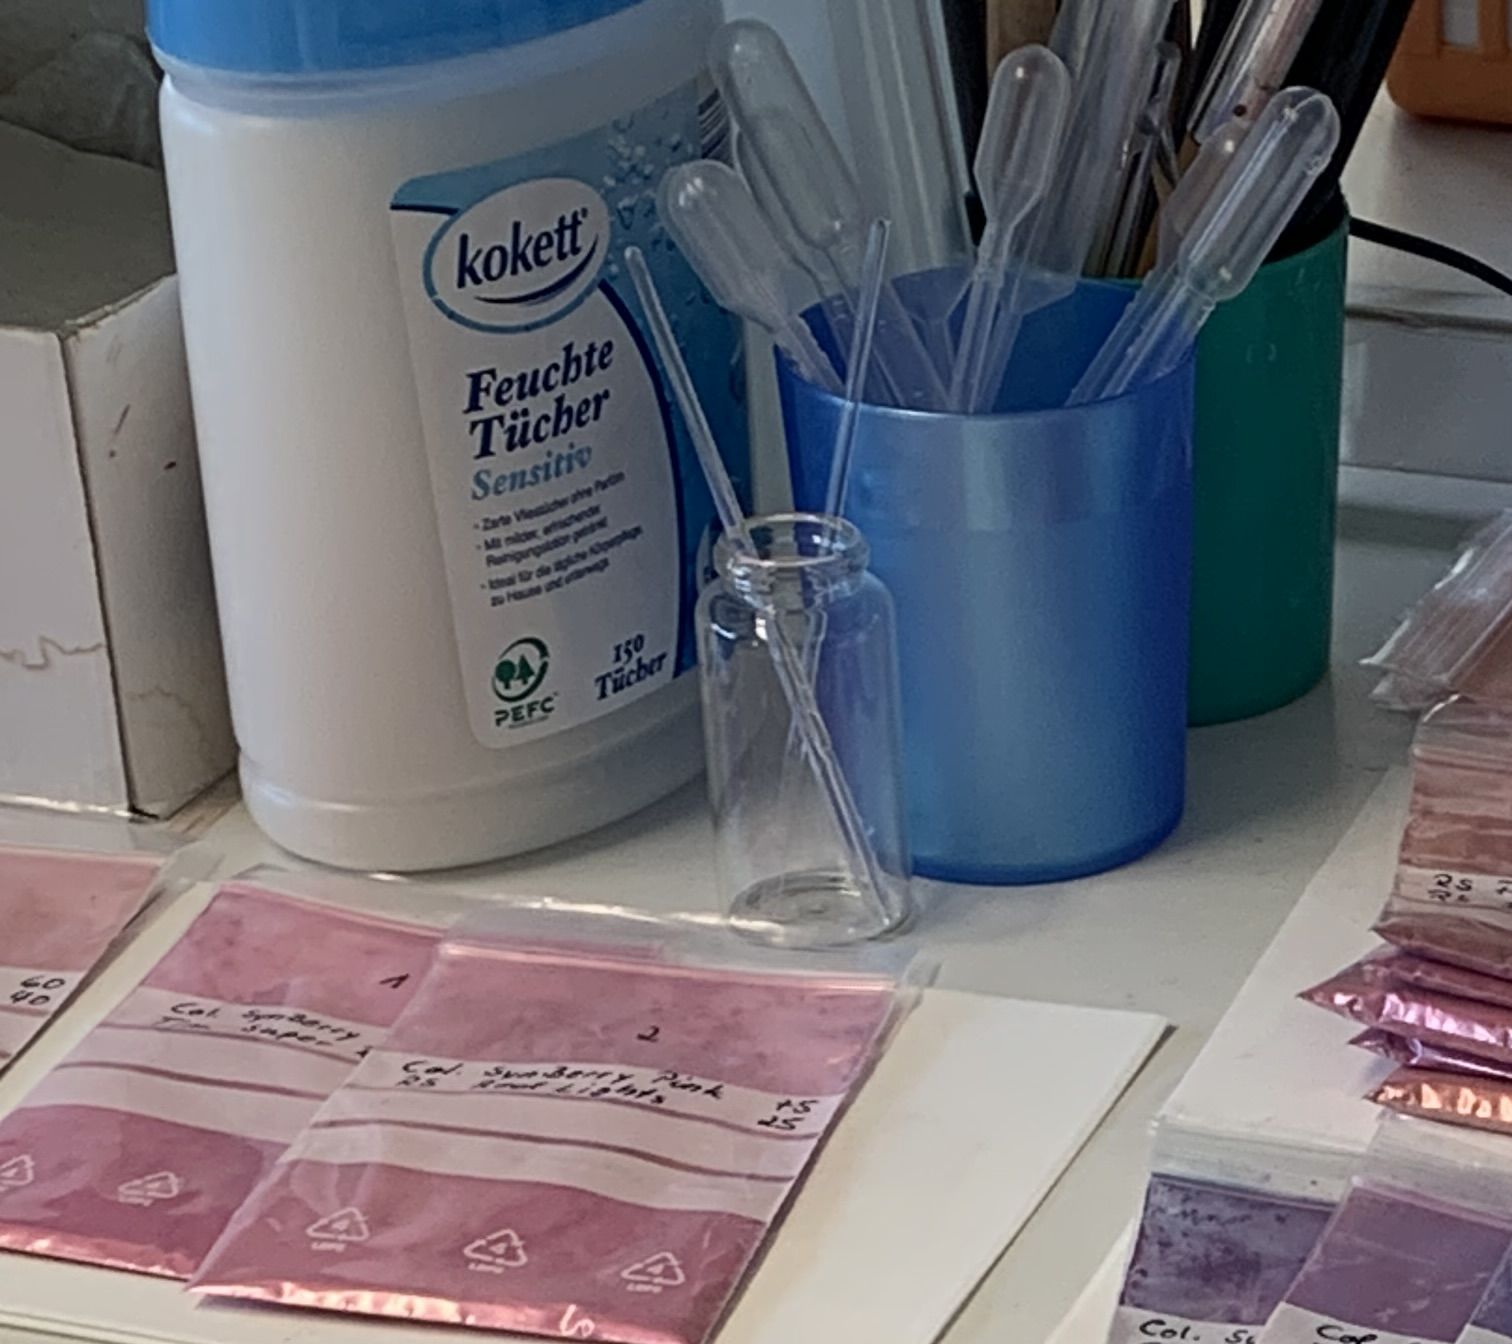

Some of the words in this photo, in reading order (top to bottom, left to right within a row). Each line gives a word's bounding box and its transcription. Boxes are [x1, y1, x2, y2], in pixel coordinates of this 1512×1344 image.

[457, 215, 583, 289] kokett
[462, 339, 614, 414] Feuchte
[469, 389, 610, 460] Tücher
[471, 442, 593, 501] Sensitiv
[613, 633, 645, 664] 150
[594, 652, 667, 701] Tücher
[494, 697, 556, 727] PEFC
[636, 1024, 660, 1043] 2
[651, 1069, 724, 1100] Pink
[1139, 1319, 1200, 1341] Col.
